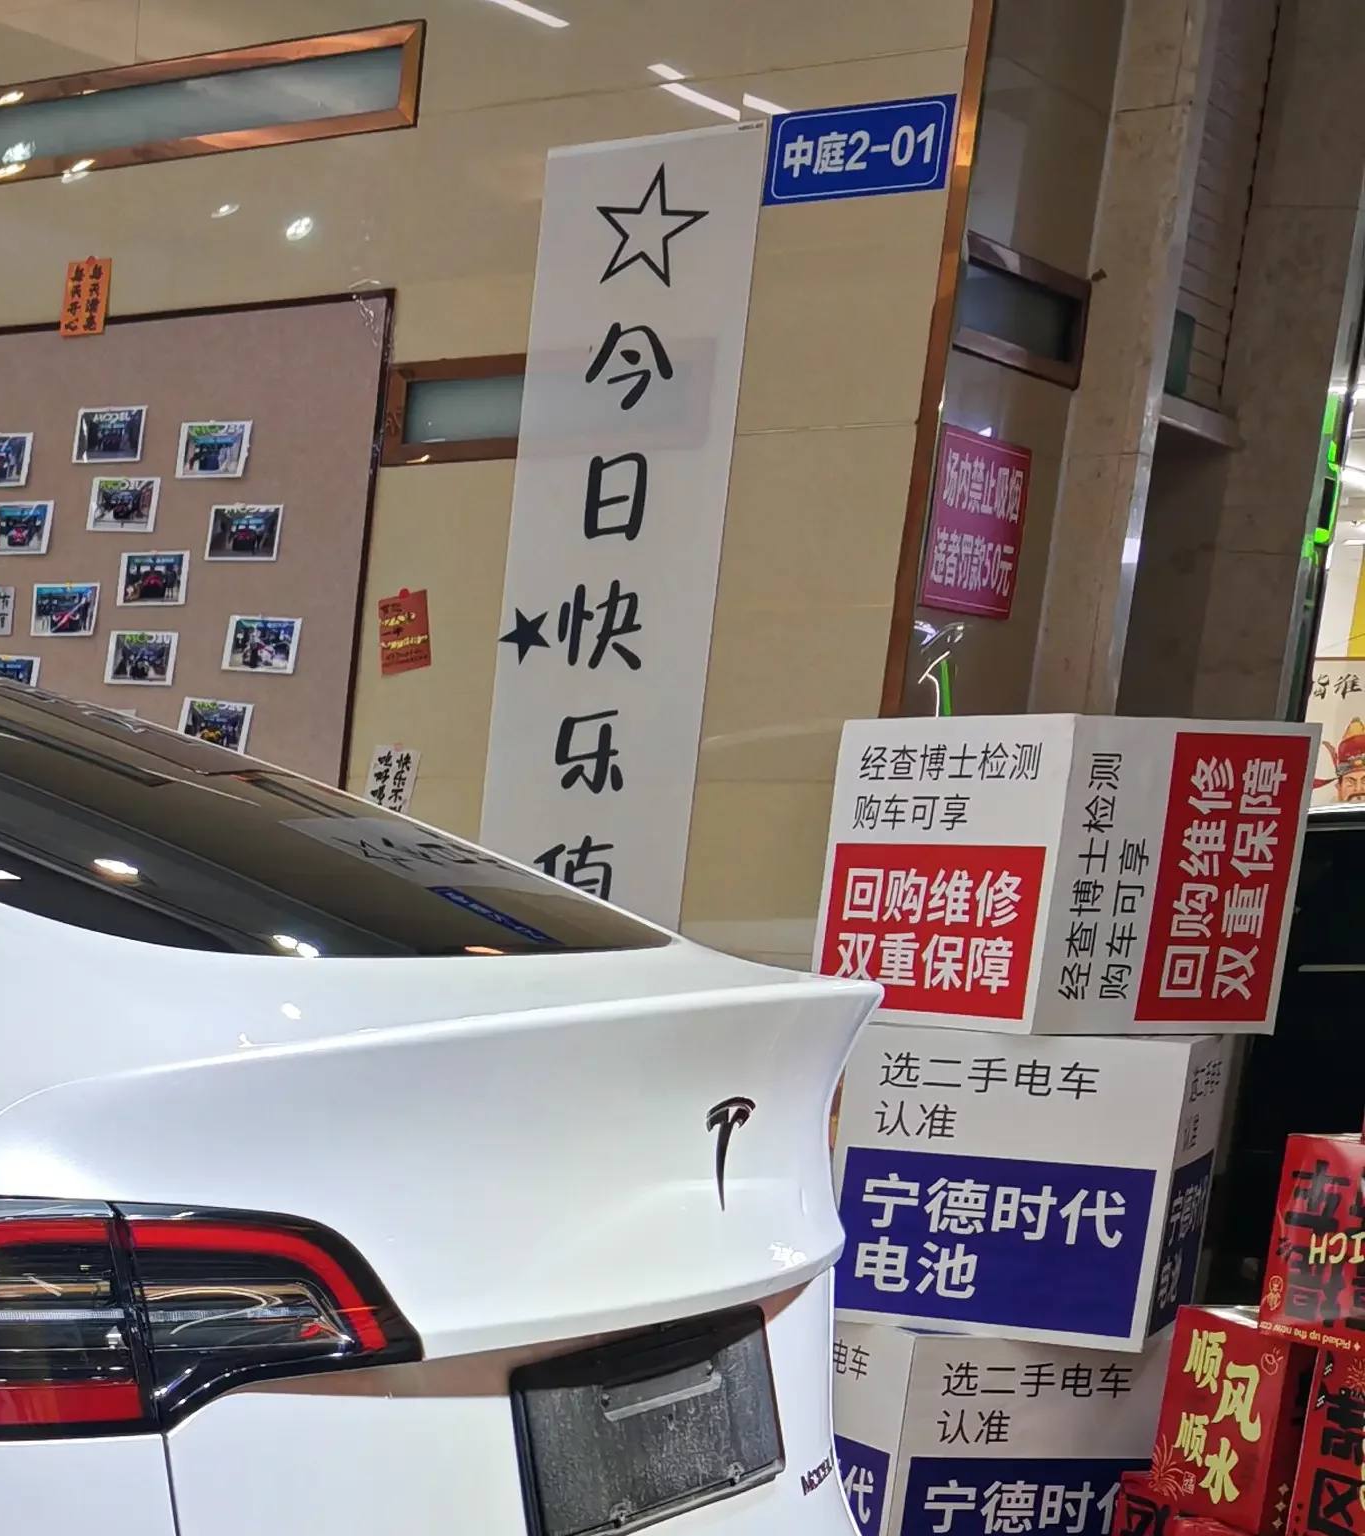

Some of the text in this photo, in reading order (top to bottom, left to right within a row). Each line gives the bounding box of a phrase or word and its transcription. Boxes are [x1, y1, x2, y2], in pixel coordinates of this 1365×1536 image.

[782, 123, 936, 178] 中庭2-01
[942, 448, 1024, 524] 场内禁止吸烟
[930, 527, 1015, 597] 违者罚款50元
[859, 742, 1043, 783] 经查博士检测
[852, 793, 971, 832] 购车可享
[840, 867, 1023, 929] 回购维修
[1057, 752, 1122, 1001] 经查博士检测
[1159, 756, 1235, 1000] 回购维修
[1211, 757, 1289, 1000] 双重保障
[1099, 837, 1151, 1001] 购车可享
[835, 932, 1015, 994] 双重保障
[878, 1051, 1101, 1100] 选二手电车
[874, 1101, 958, 1139] 认准
[861, 1172, 1126, 1249] 宁德时代
[853, 1236, 980, 1300] 电池
[941, 1361, 1133, 1399] 选二手电车
[936, 1409, 1012, 1445] 认准
